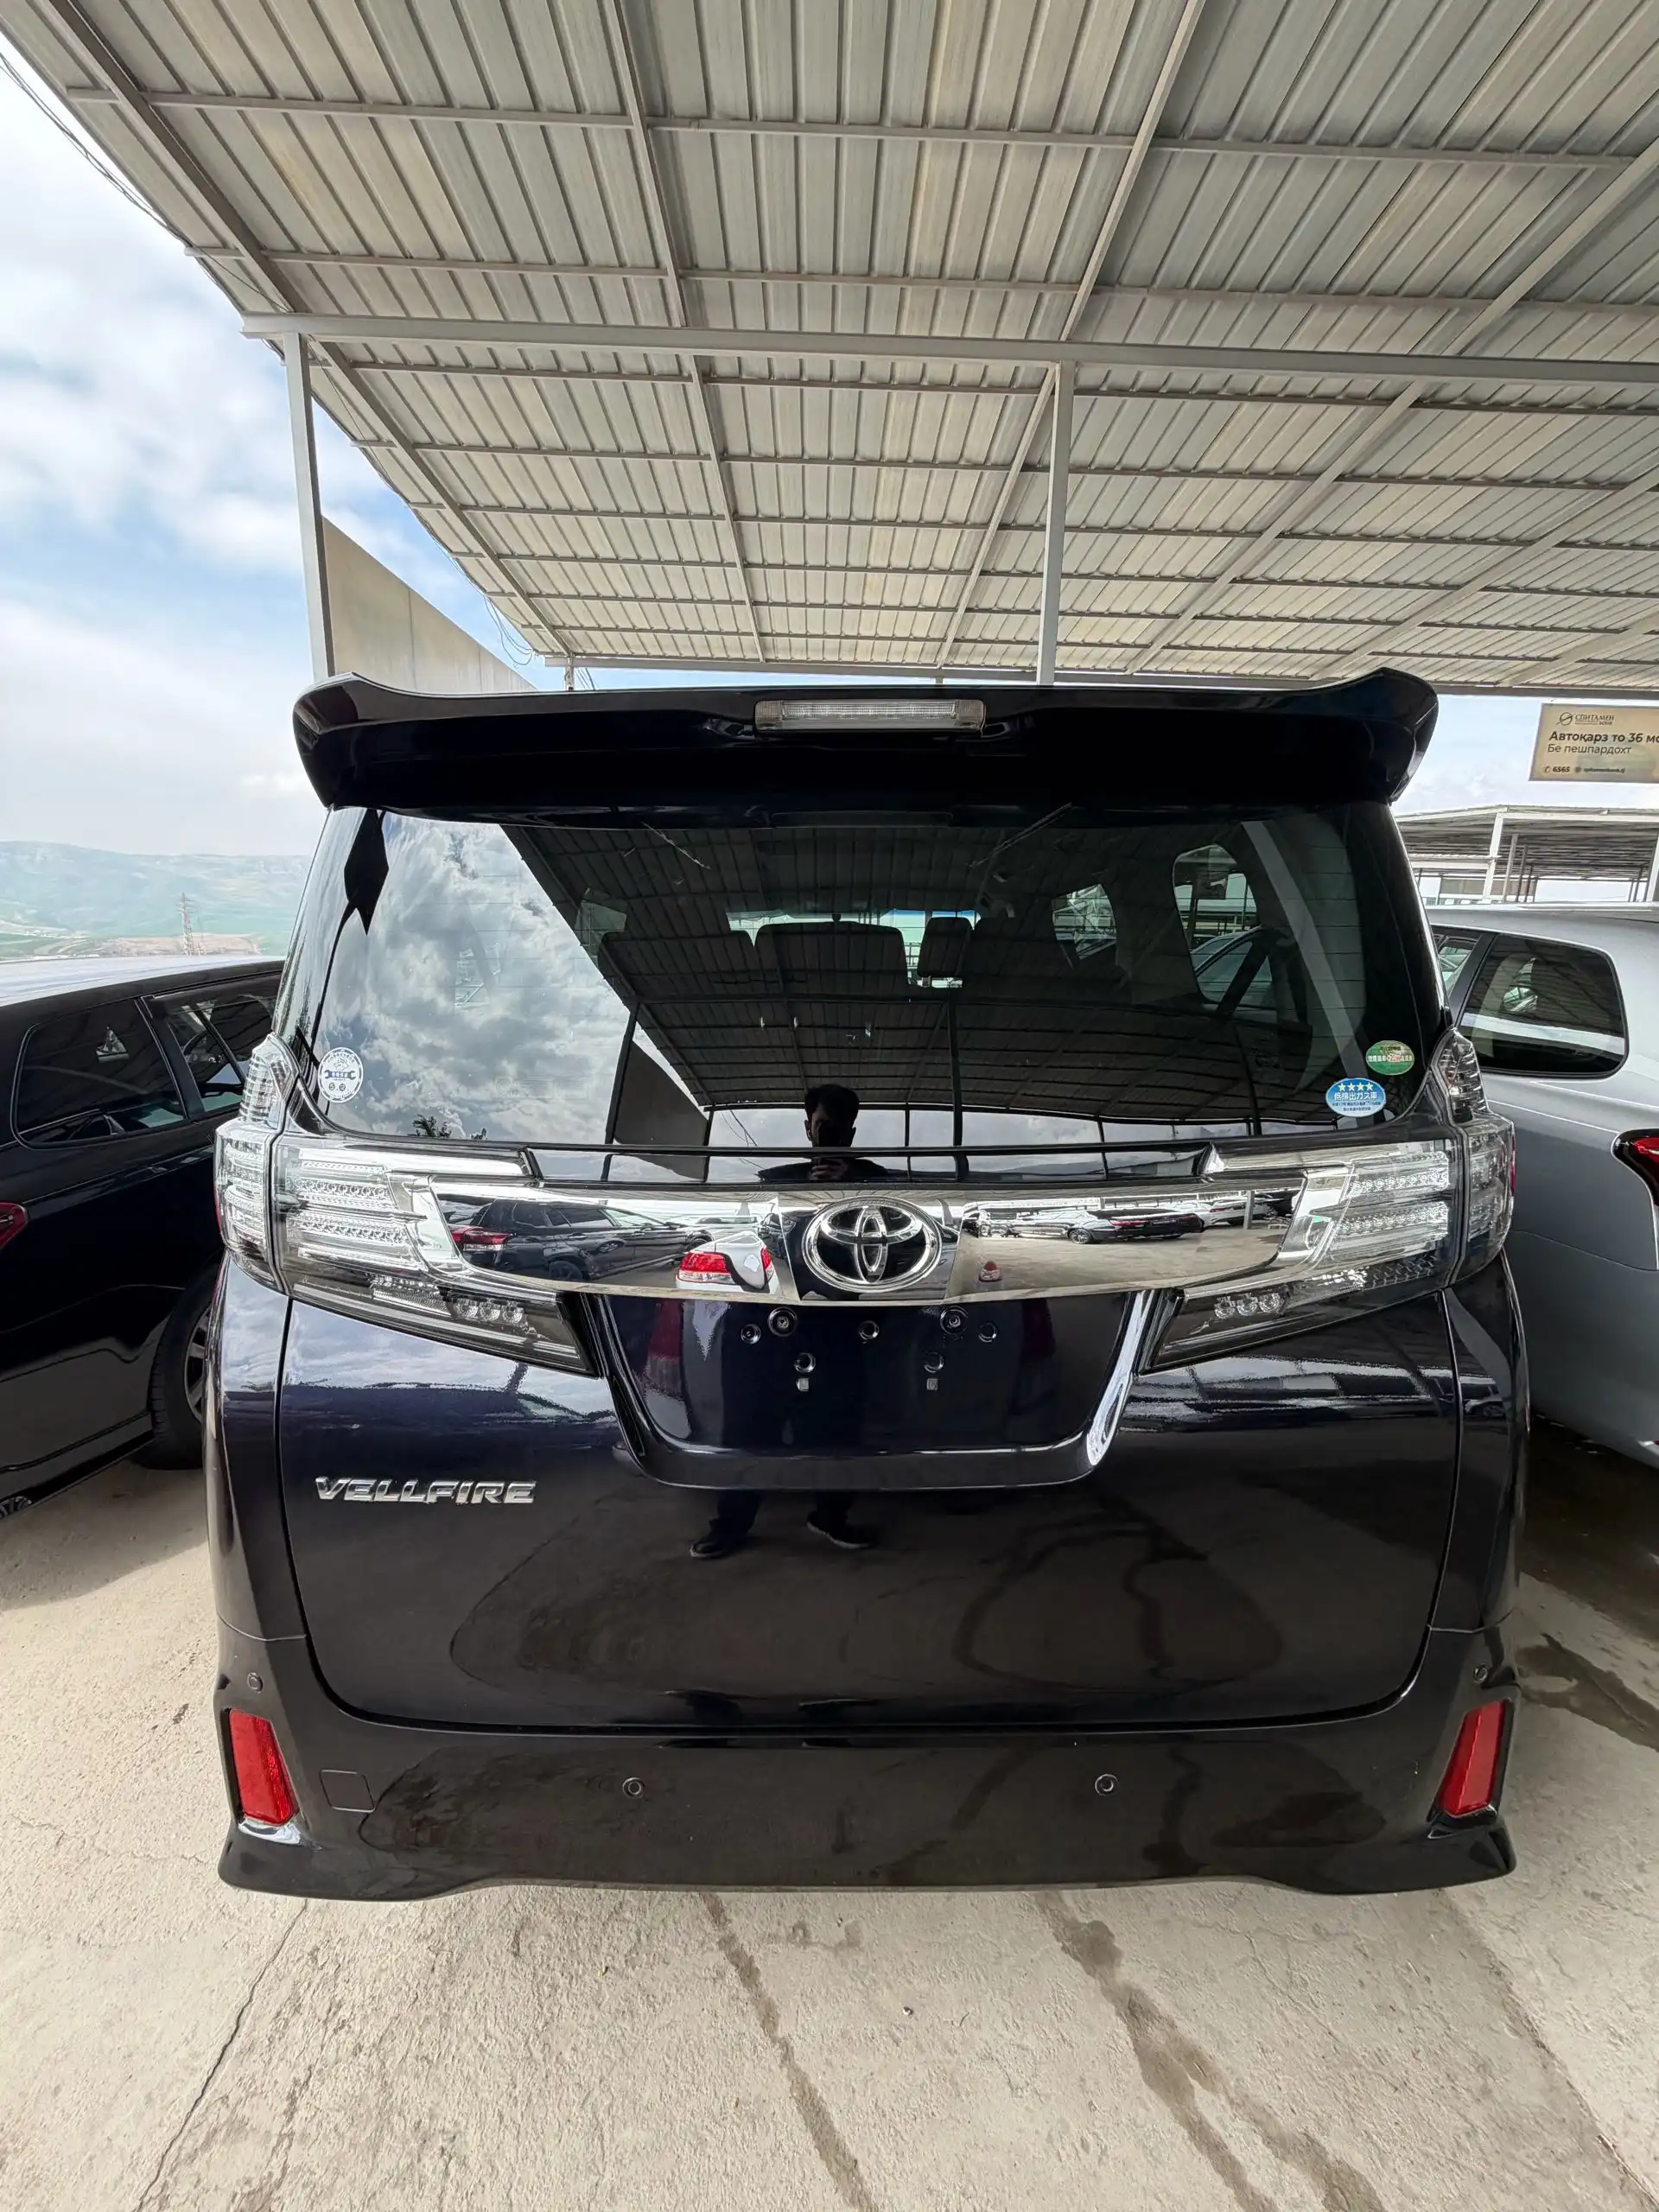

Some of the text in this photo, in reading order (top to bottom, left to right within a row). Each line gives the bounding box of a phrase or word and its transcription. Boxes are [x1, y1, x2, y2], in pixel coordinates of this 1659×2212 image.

[1548, 731, 1608, 744] Автоқарз
[1628, 733, 1643, 743] 36
[1548, 743, 1631, 755] Бе пешпардохт
[1334, 1091, 1377, 1101] 低排出ガス車
[315, 1476, 537, 1504] VELLFIRE
